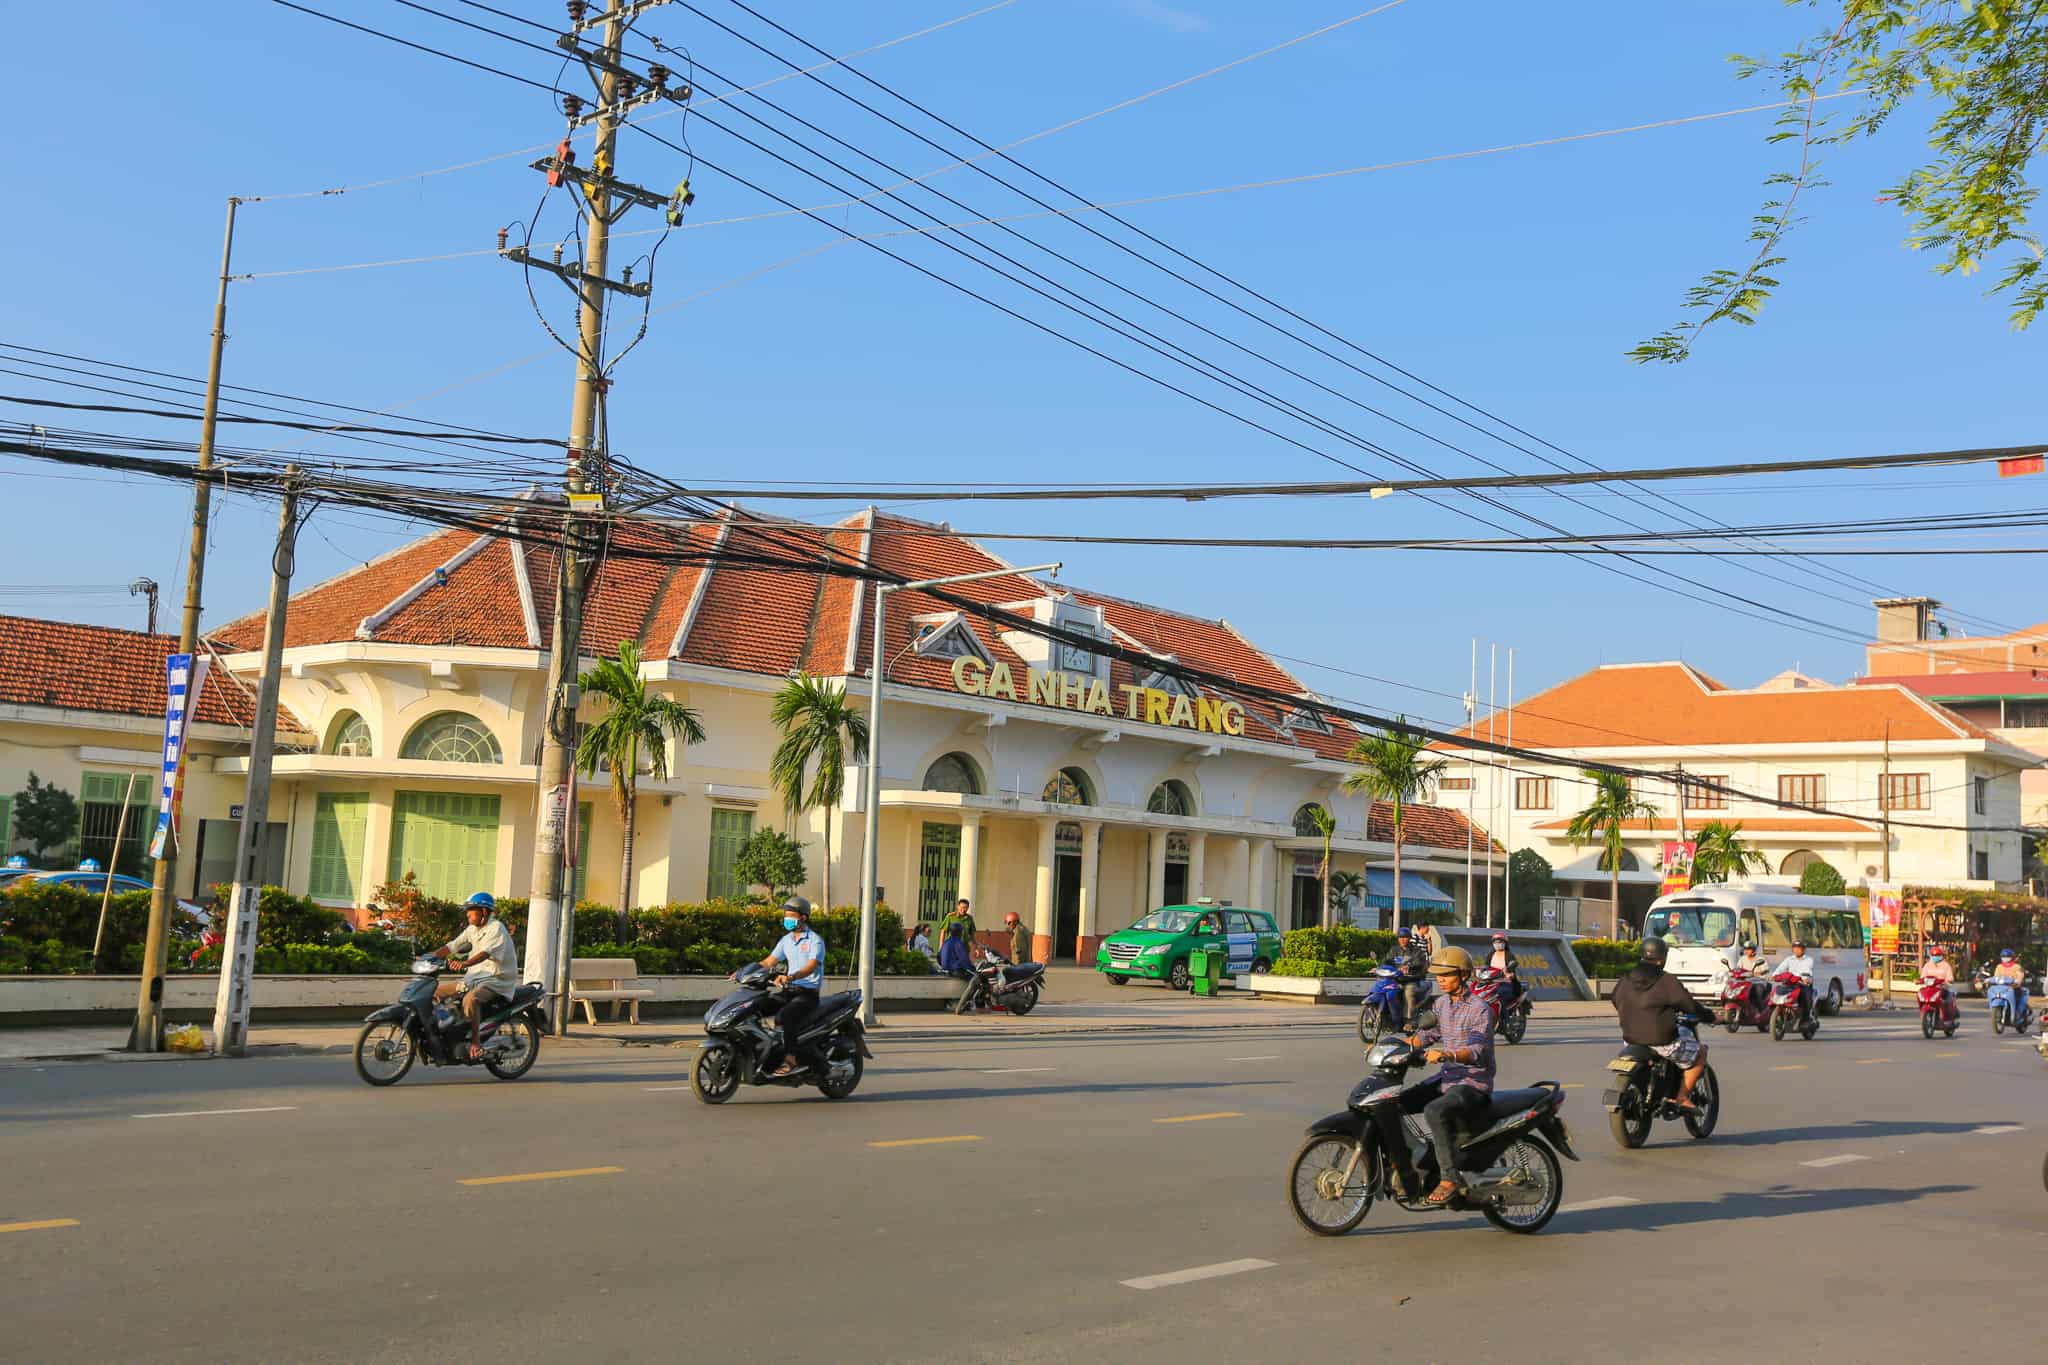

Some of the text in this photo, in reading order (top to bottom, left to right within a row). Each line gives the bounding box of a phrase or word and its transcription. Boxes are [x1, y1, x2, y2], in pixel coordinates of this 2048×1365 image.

[951, 655, 1246, 736] GA NHA TRANG
